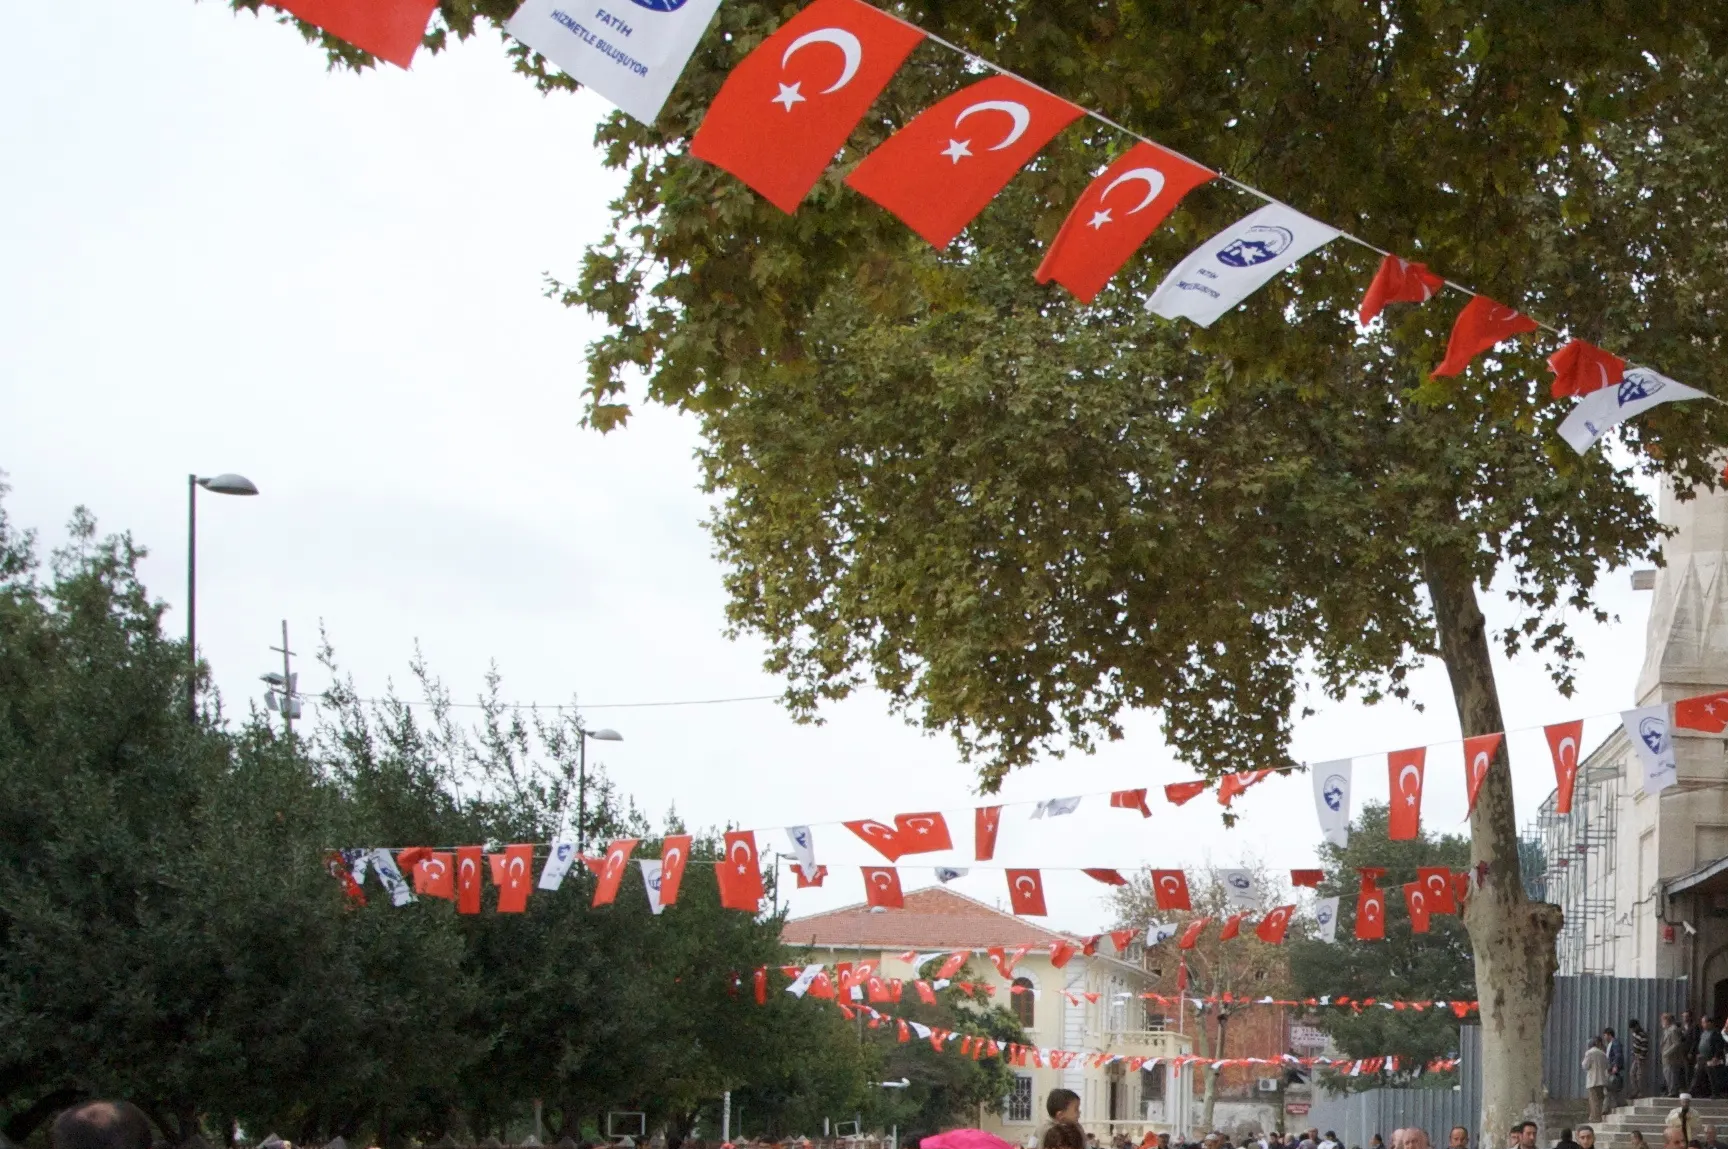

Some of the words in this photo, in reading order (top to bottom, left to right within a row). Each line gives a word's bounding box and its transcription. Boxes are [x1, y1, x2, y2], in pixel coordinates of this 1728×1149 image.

[551, 9, 597, 45] HİZMETLE
[596, 39, 648, 77] BULUŞUYOR
[595, 9, 633, 37] FATİH
